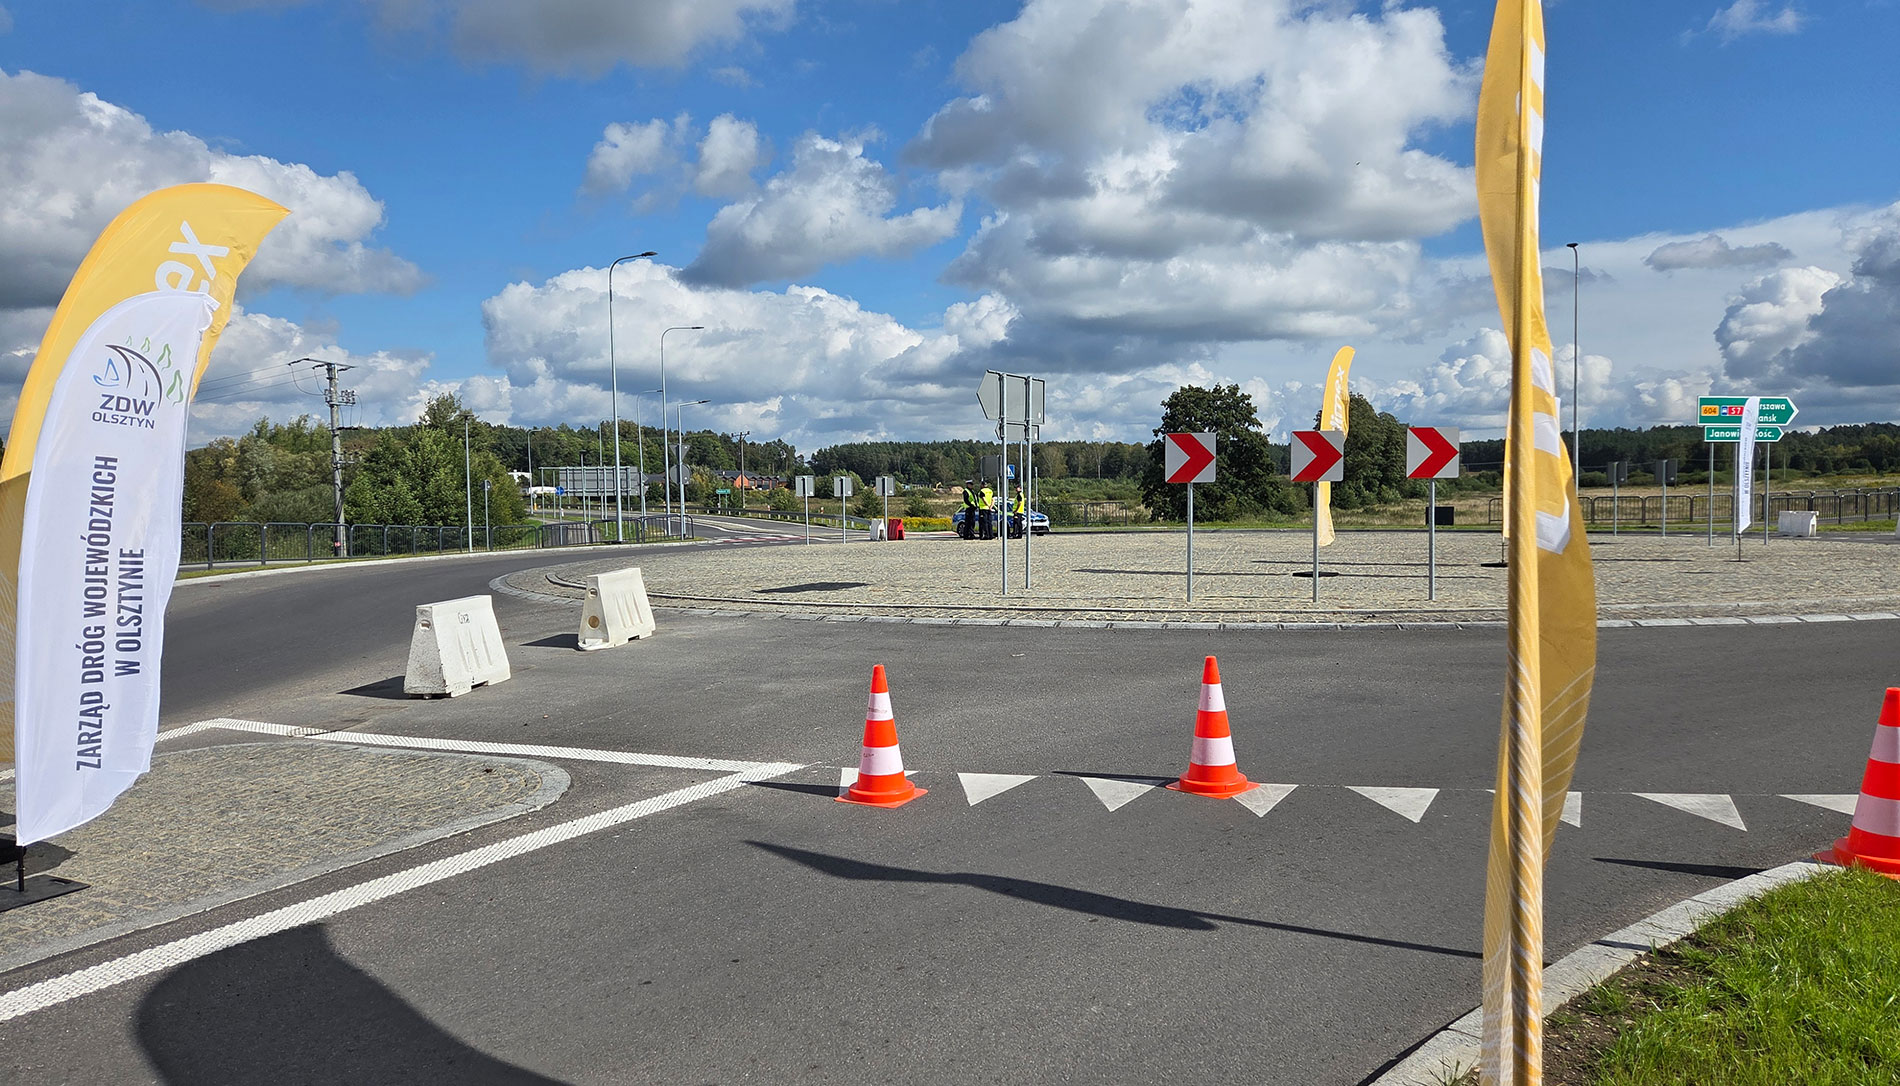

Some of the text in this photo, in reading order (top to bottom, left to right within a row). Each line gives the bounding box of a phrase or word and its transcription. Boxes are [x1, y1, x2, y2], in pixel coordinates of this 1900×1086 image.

[99, 393, 156, 416] ZDW
[1703, 407, 1741, 415] 604 S7
[1759, 403, 1786, 411] rszawa
[92, 411, 156, 429] OLSZTYN
[1758, 413, 1777, 422] ańsk
[1709, 429, 1740, 438] Janowi
[75, 455, 118, 771] ZARZĄD DRÓG WOJEWÓDZKICH
[114, 547, 145, 677] W OLSZTYNIE
